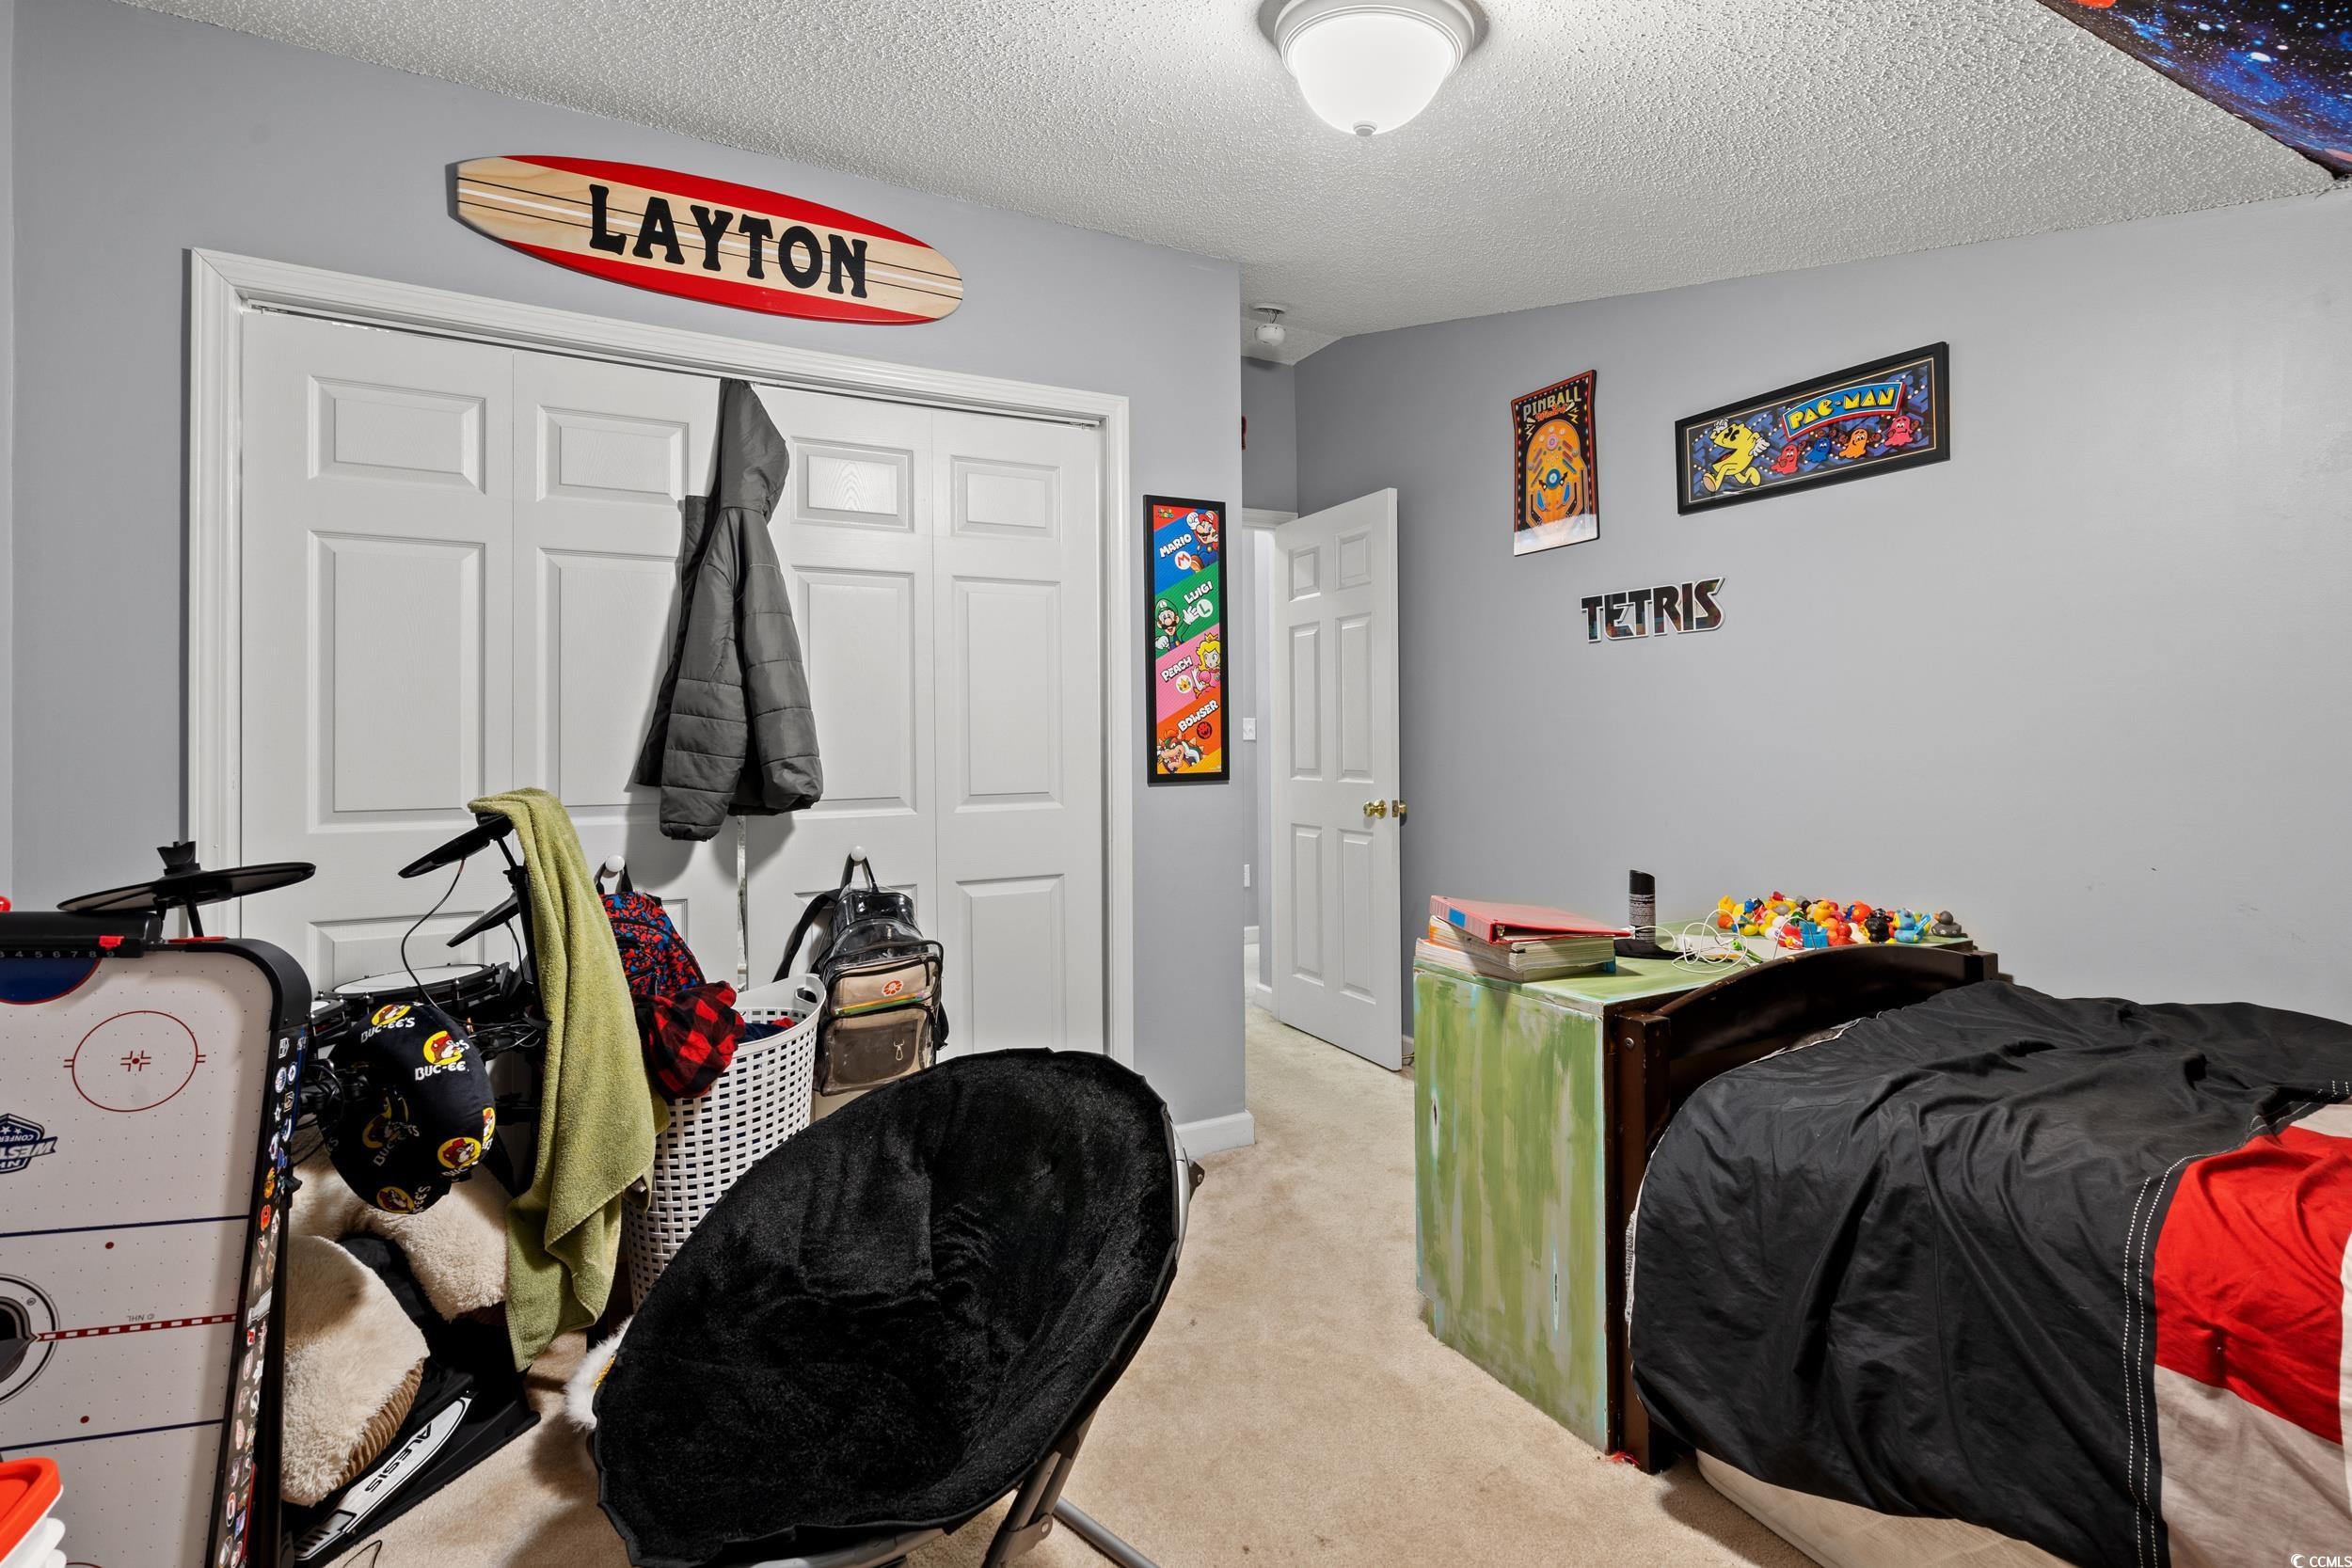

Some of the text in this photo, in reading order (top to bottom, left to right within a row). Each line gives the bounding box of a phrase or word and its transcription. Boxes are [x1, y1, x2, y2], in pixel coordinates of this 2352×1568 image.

[589, 183, 867, 298] LAYTON
[1522, 386, 1581, 422] PINBALL
[1788, 387, 1895, 430] PAC-MAN
[1159, 533, 1192, 558] MARIO
[1183, 580, 1214, 604] LUIGI
[1581, 577, 1725, 643] TETRIS
[1160, 656, 1193, 683] PEACH
[1177, 699, 1219, 732] BOWSER
[364, 1422, 433, 1493] ALESIS
